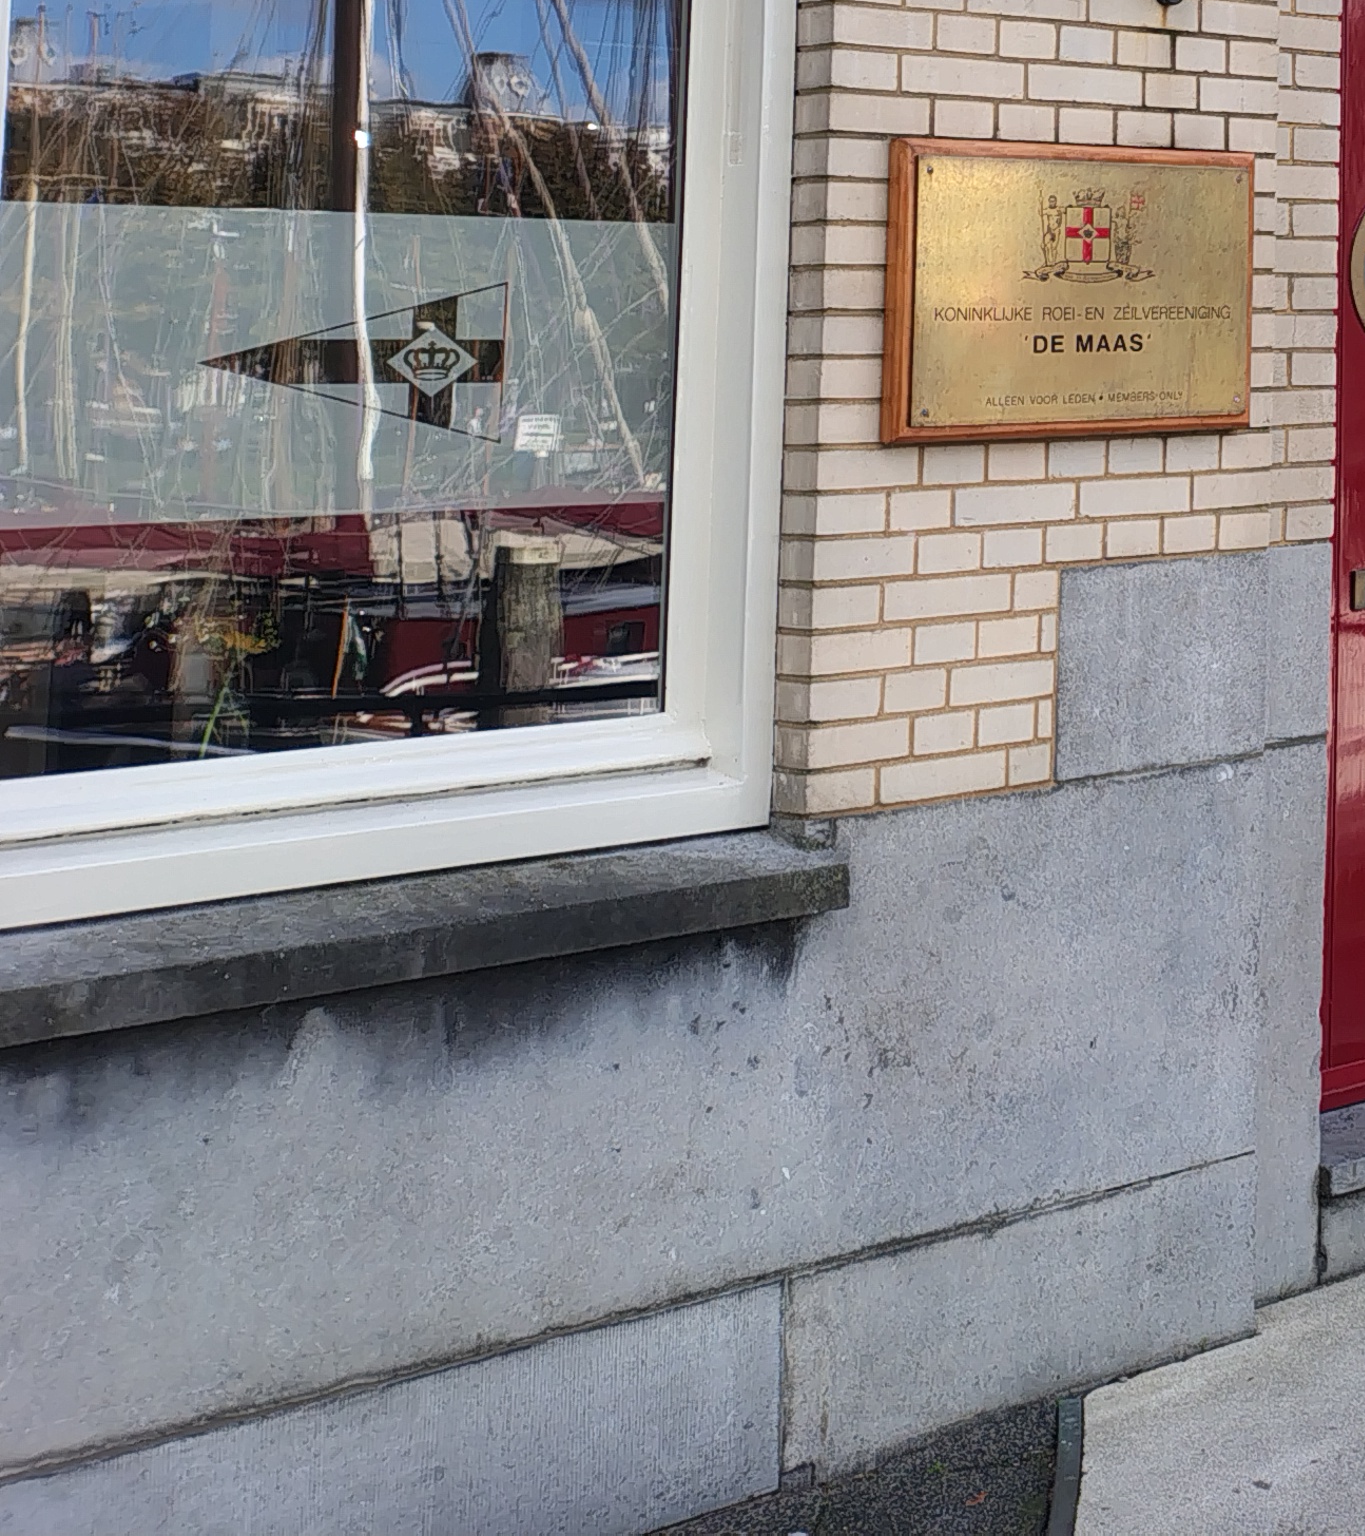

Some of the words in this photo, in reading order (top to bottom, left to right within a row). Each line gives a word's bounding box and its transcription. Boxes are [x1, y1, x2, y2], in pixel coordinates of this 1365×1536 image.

[933, 306, 1032, 322] KONINKLIJKE
[1113, 305, 1231, 321] ZEILVEREENIGING
[985, 395, 1025, 407] ALLEEN
[1029, 394, 1058, 405] VOOR
[1062, 392, 1096, 405] LEDEN
